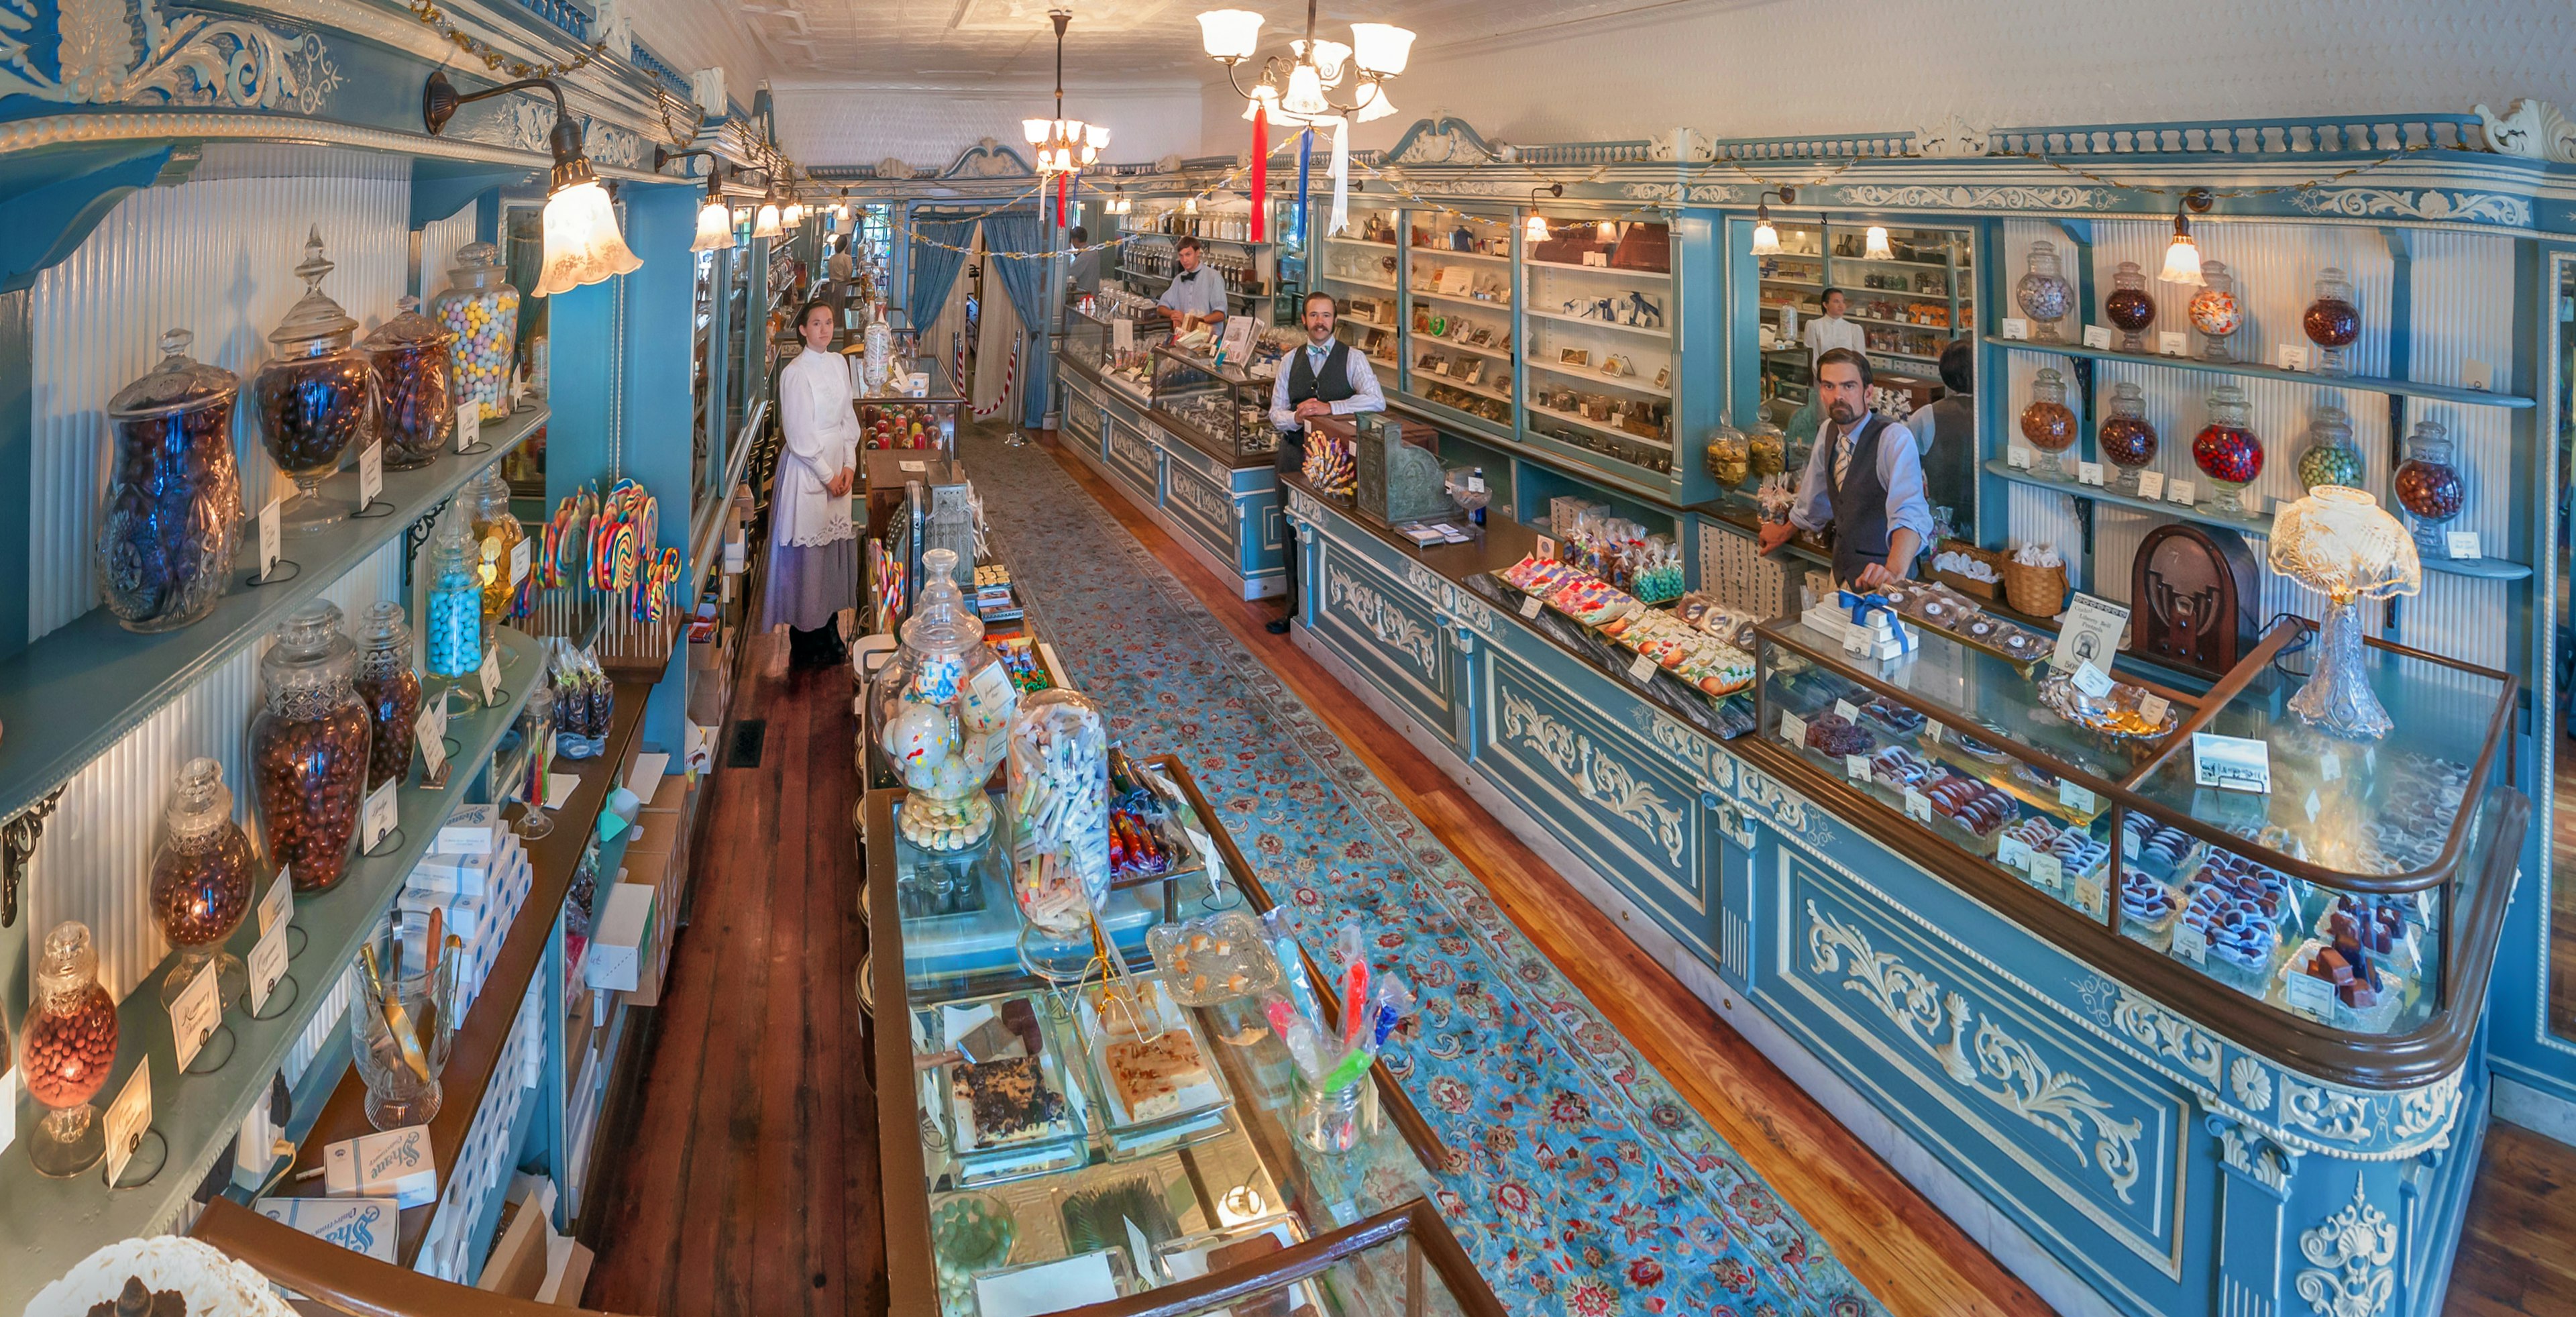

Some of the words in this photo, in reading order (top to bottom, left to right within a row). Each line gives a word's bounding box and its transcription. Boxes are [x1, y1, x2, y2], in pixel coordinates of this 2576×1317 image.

[2079, 613, 2098, 625] Liberty
[2100, 621, 2112, 629] Bell
[445, 805, 490, 826] Shane
[371, 1131, 421, 1179] Shane
[311, 1207, 357, 1236] Confection
[325, 1205, 380, 1254] Sha
